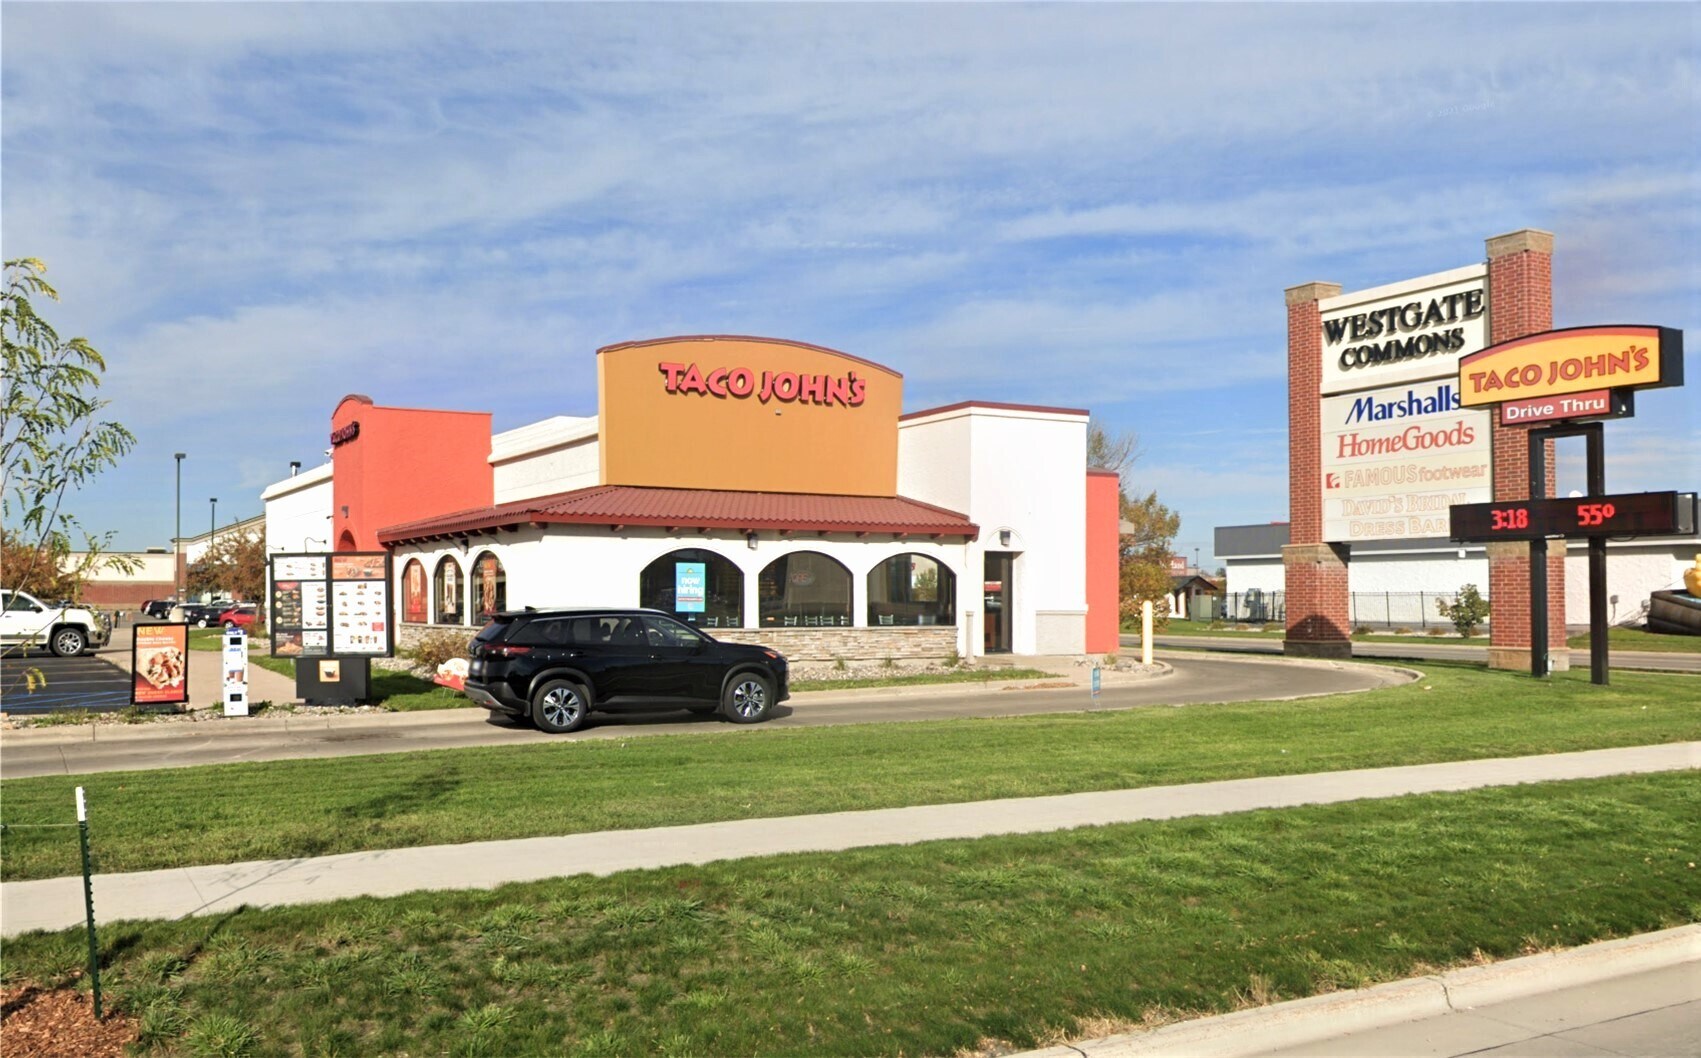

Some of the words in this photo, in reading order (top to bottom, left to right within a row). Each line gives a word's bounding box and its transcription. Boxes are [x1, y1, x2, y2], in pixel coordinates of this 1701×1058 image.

[1323, 288, 1485, 344] WESTGATE
[1339, 327, 1465, 368] COMMONS
[659, 362, 754, 399] TACO
[758, 371, 866, 408] JOHN'S
[1469, 363, 1542, 393] TACO
[1547, 345, 1649, 386] JOHN'S
[1345, 385, 1460, 425] Marshalls
[1506, 403, 1554, 420] Drive
[1560, 398, 1605, 413] Thru
[1336, 420, 1475, 458] HomeGoods
[1342, 496, 1404, 516] DAVID'S
[1490, 508, 1528, 530] 3:18
[1350, 520, 1405, 537] DRESS
[1408, 516, 1448, 534] BAR
[138, 626, 165, 637] NEW
